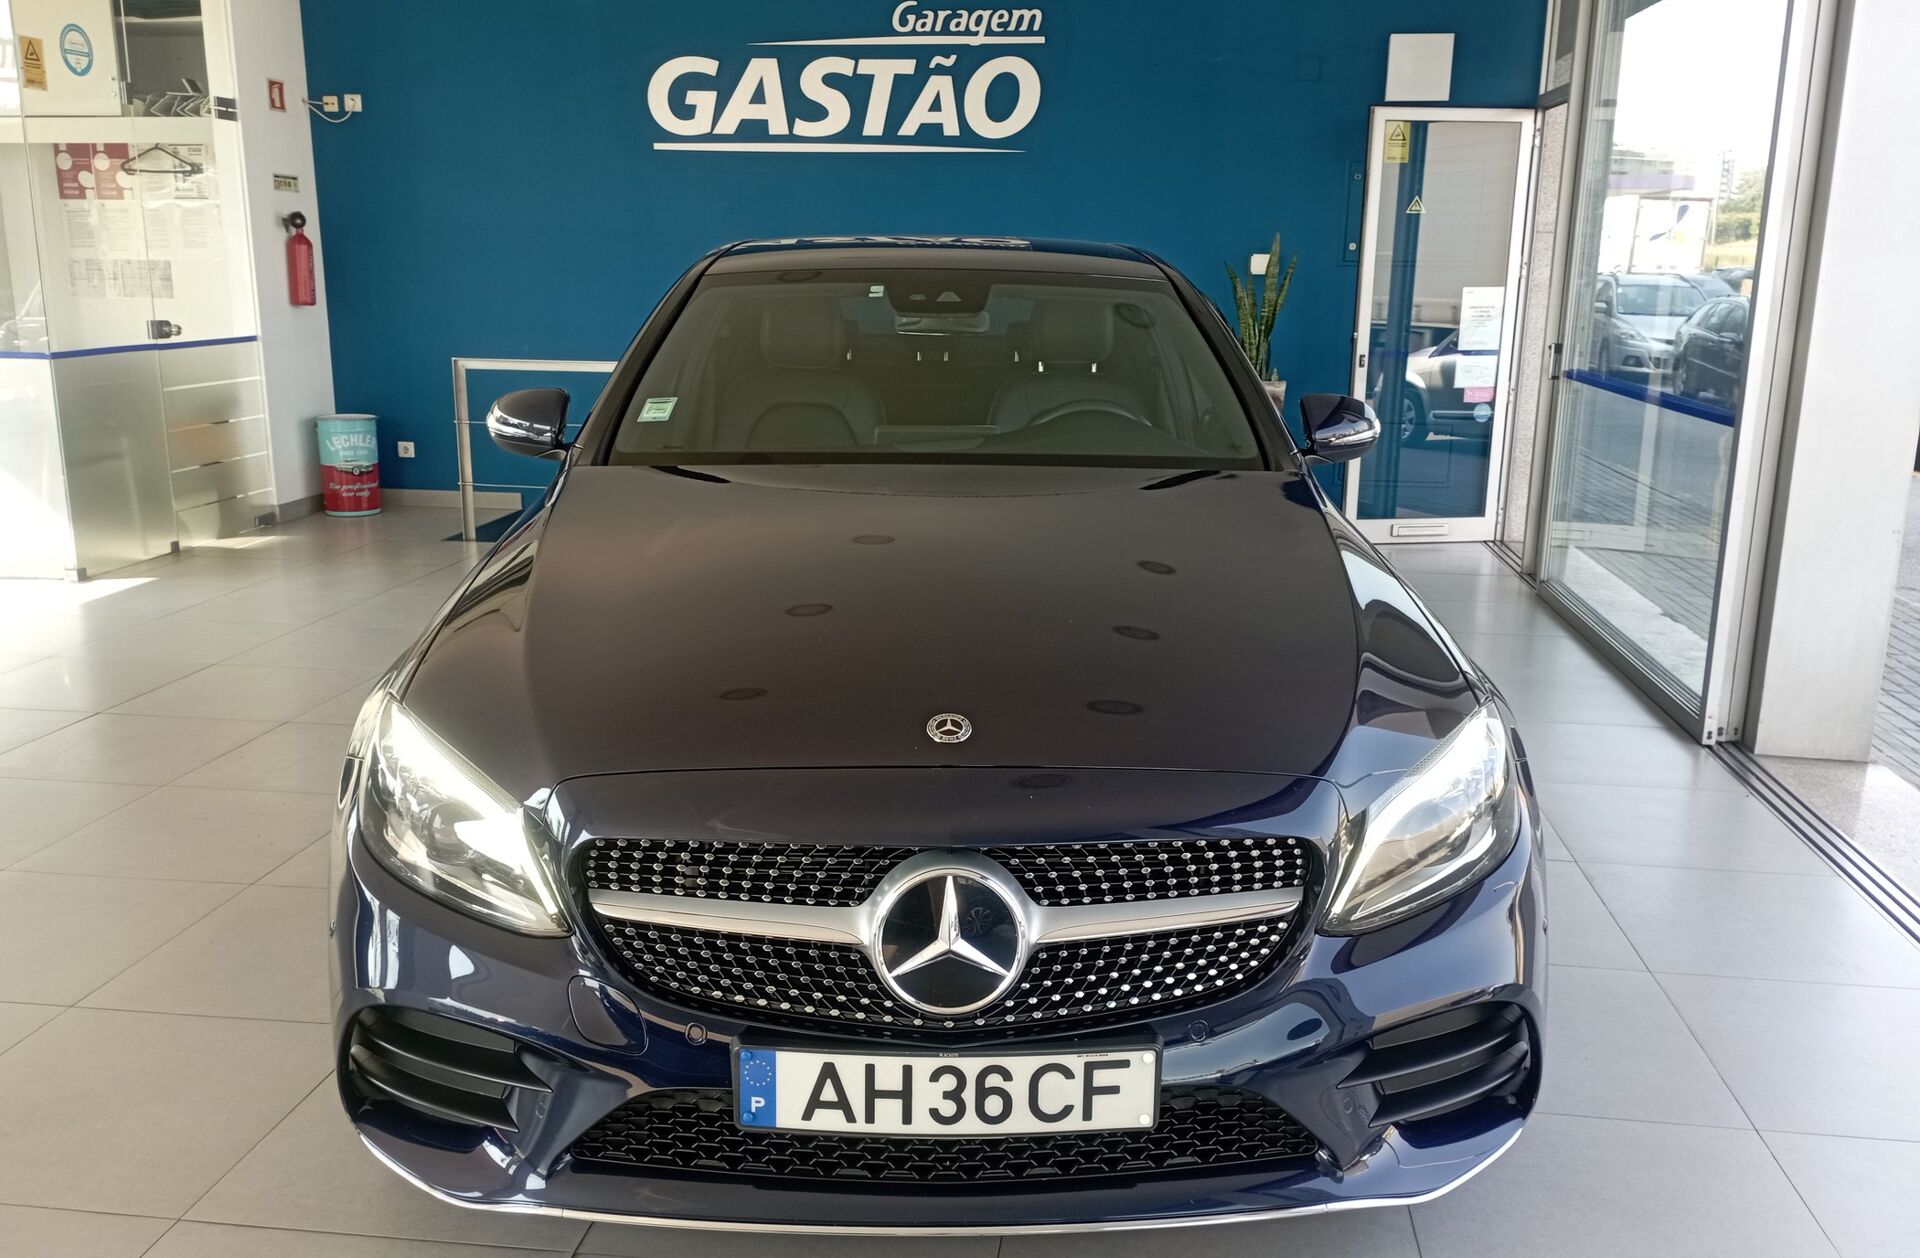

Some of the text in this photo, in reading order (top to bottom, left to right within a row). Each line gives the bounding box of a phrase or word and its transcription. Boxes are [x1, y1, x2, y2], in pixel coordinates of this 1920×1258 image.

[892, 0, 1043, 45] Garagem
[646, 53, 1042, 140] GASTÃO
[751, 1096, 766, 1113] P
